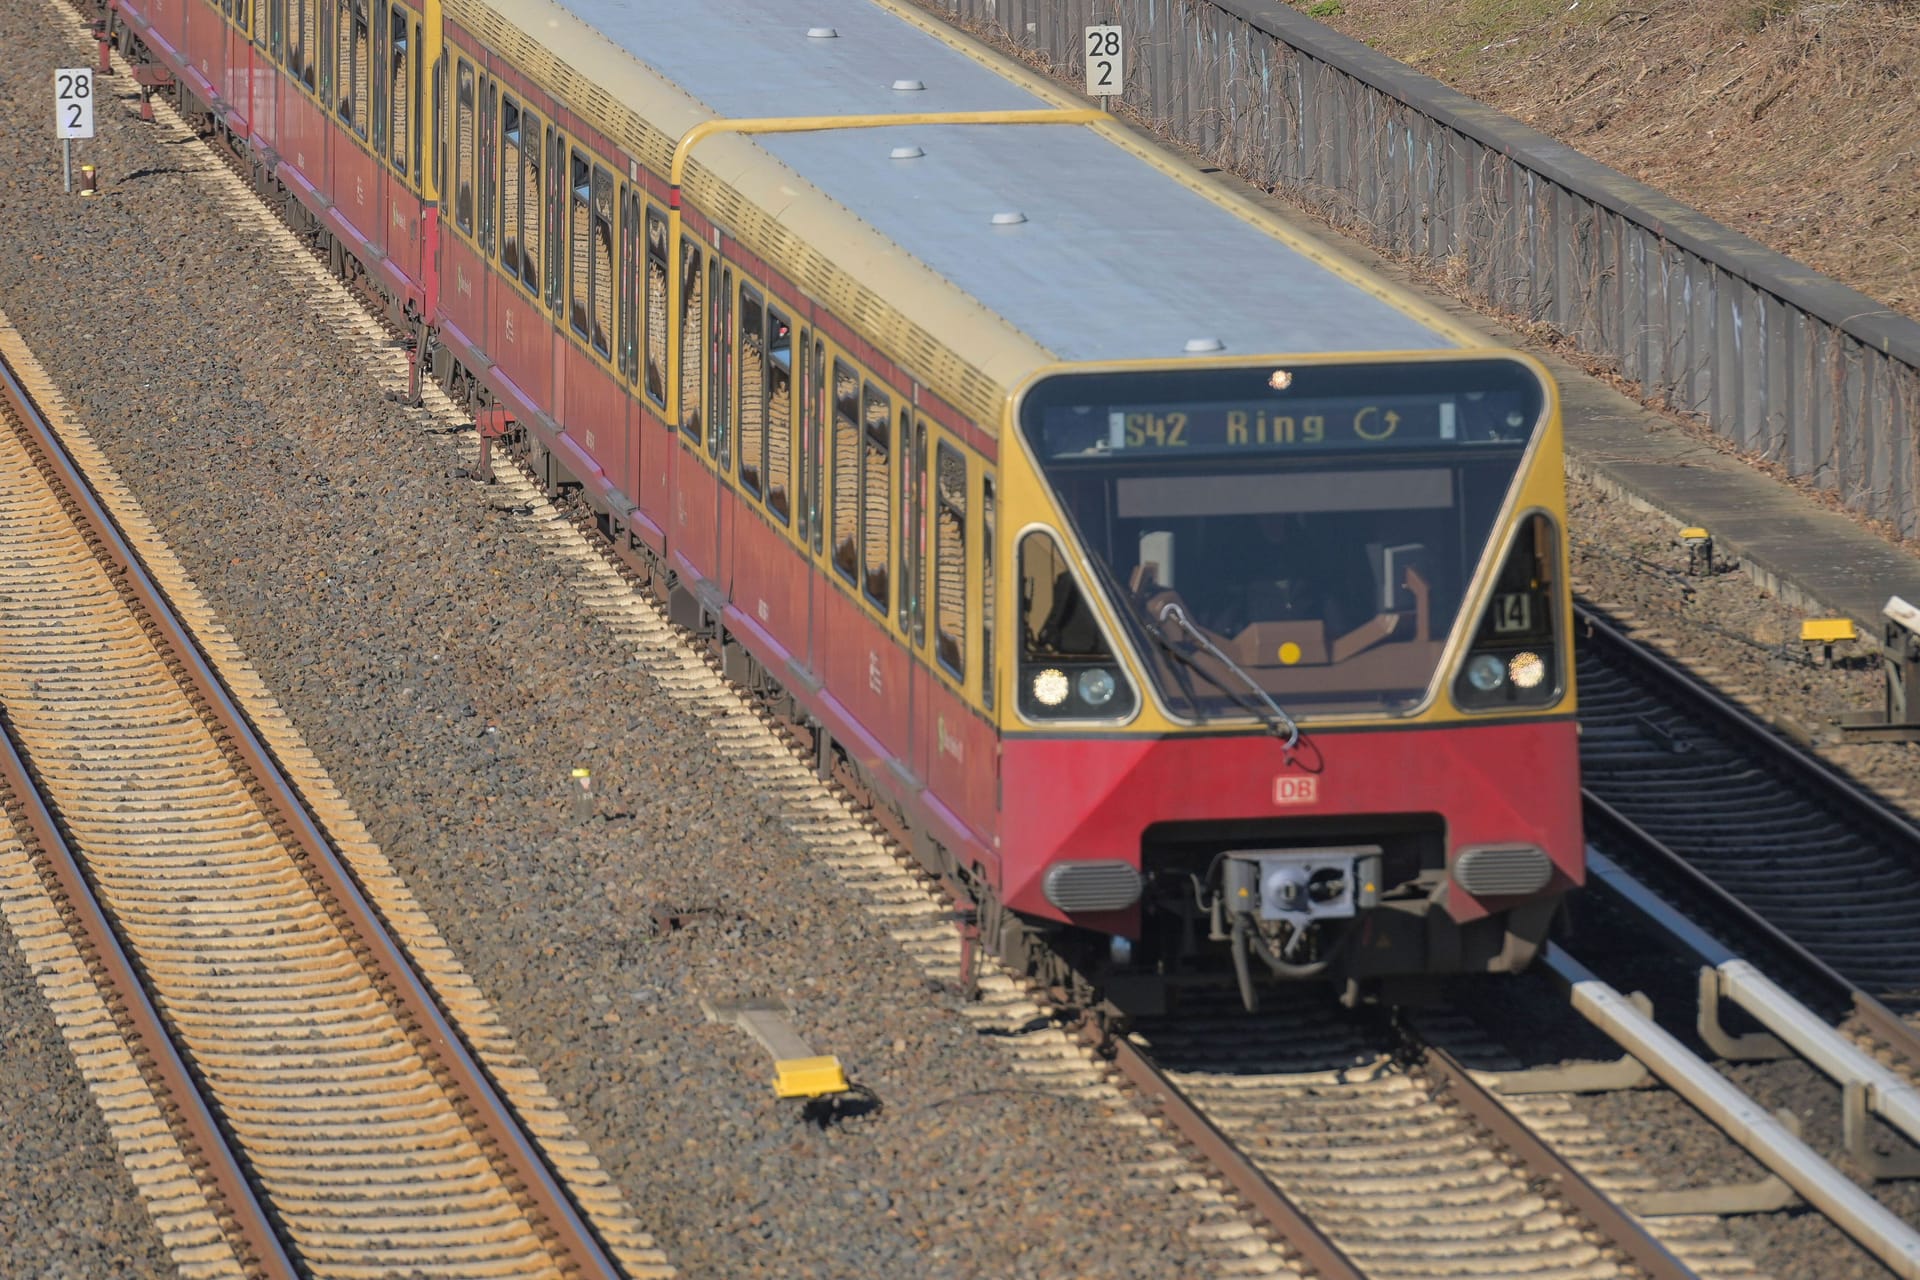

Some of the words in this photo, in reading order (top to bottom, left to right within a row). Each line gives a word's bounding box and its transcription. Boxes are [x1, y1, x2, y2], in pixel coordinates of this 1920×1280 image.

[1088, 32, 1119, 56] 28
[1097, 61, 1112, 85] 2
[58, 75, 89, 99] 28
[68, 104, 82, 128] 2
[1125, 412, 1188, 447] S42
[1227, 410, 1324, 445] Ring
[1496, 593, 1525, 628] 14
[1279, 779, 1313, 799] DB
